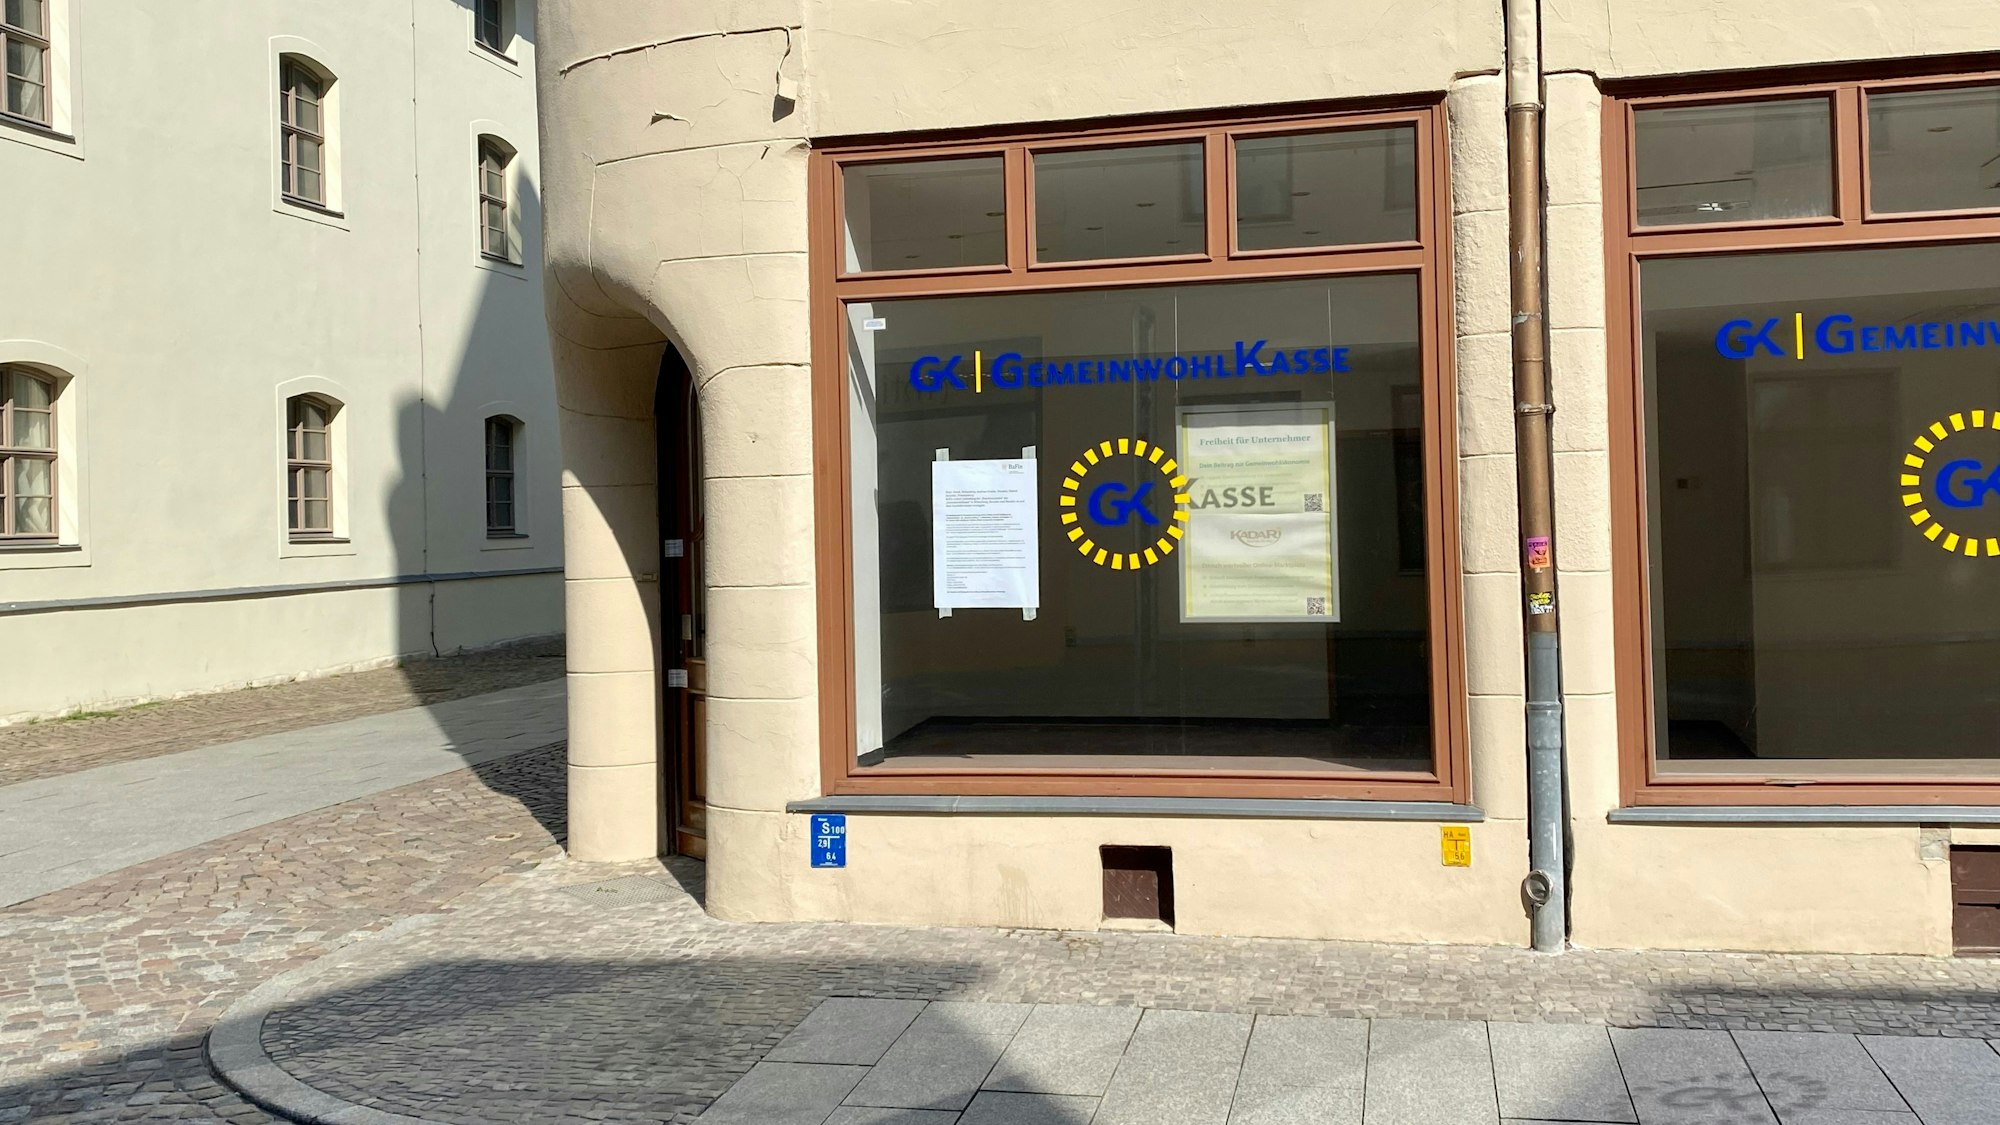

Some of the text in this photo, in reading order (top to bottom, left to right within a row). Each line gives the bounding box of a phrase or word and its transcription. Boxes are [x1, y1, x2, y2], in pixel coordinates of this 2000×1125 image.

[1715, 318, 1786, 360] GK
[909, 355, 968, 392] GK
[1200, 434, 1311, 446] Freiheit für Unternehmer
[1088, 481, 1161, 527] GK
[822, 822, 845, 834] S 100
